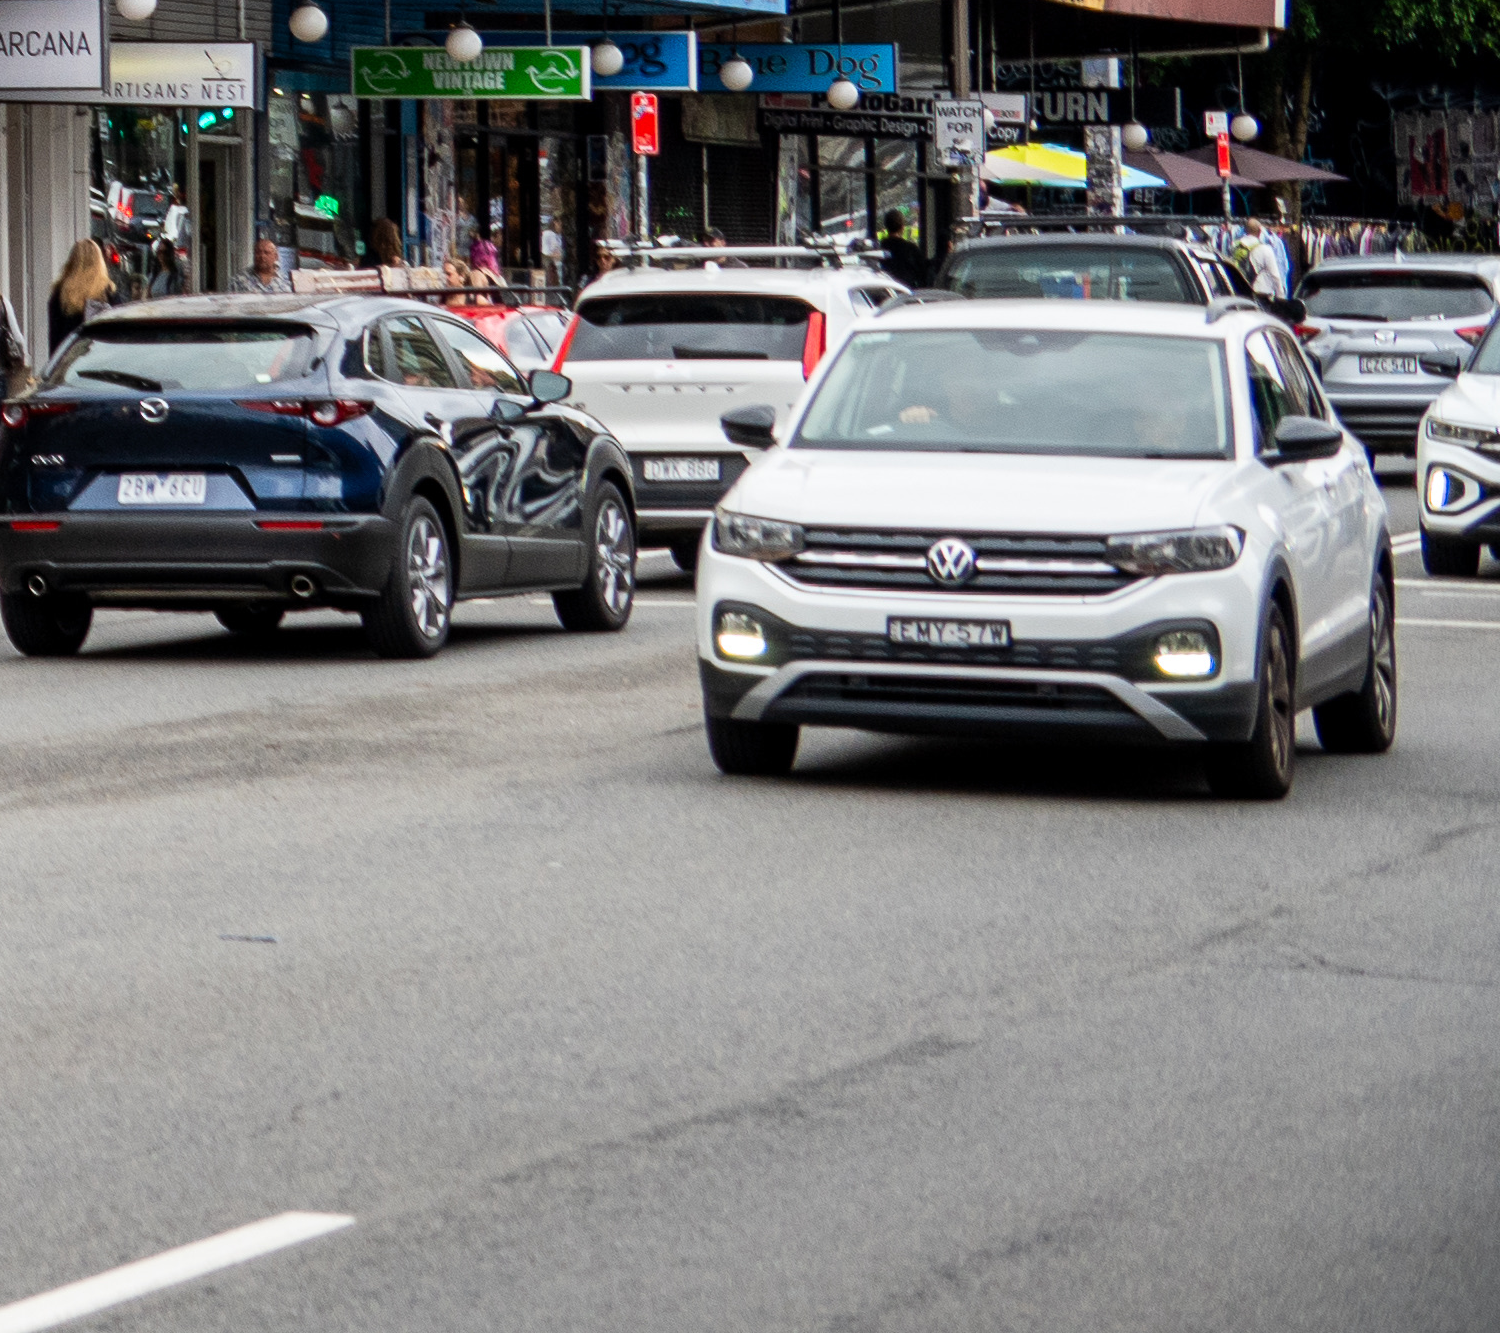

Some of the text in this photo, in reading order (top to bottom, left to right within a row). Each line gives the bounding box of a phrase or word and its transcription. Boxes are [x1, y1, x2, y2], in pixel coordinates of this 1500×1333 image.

[808, 49, 881, 92] Dog
[432, 71, 506, 90] VINTAGE
[202, 82, 247, 101] NEST
[936, 106, 982, 119] WATCH
[763, 113, 798, 128] Digital
[801, 116, 825, 129] Print
[832, 118, 877, 133] Graphic
[879, 119, 918, 135] Design
[946, 121, 974, 134] FOR
